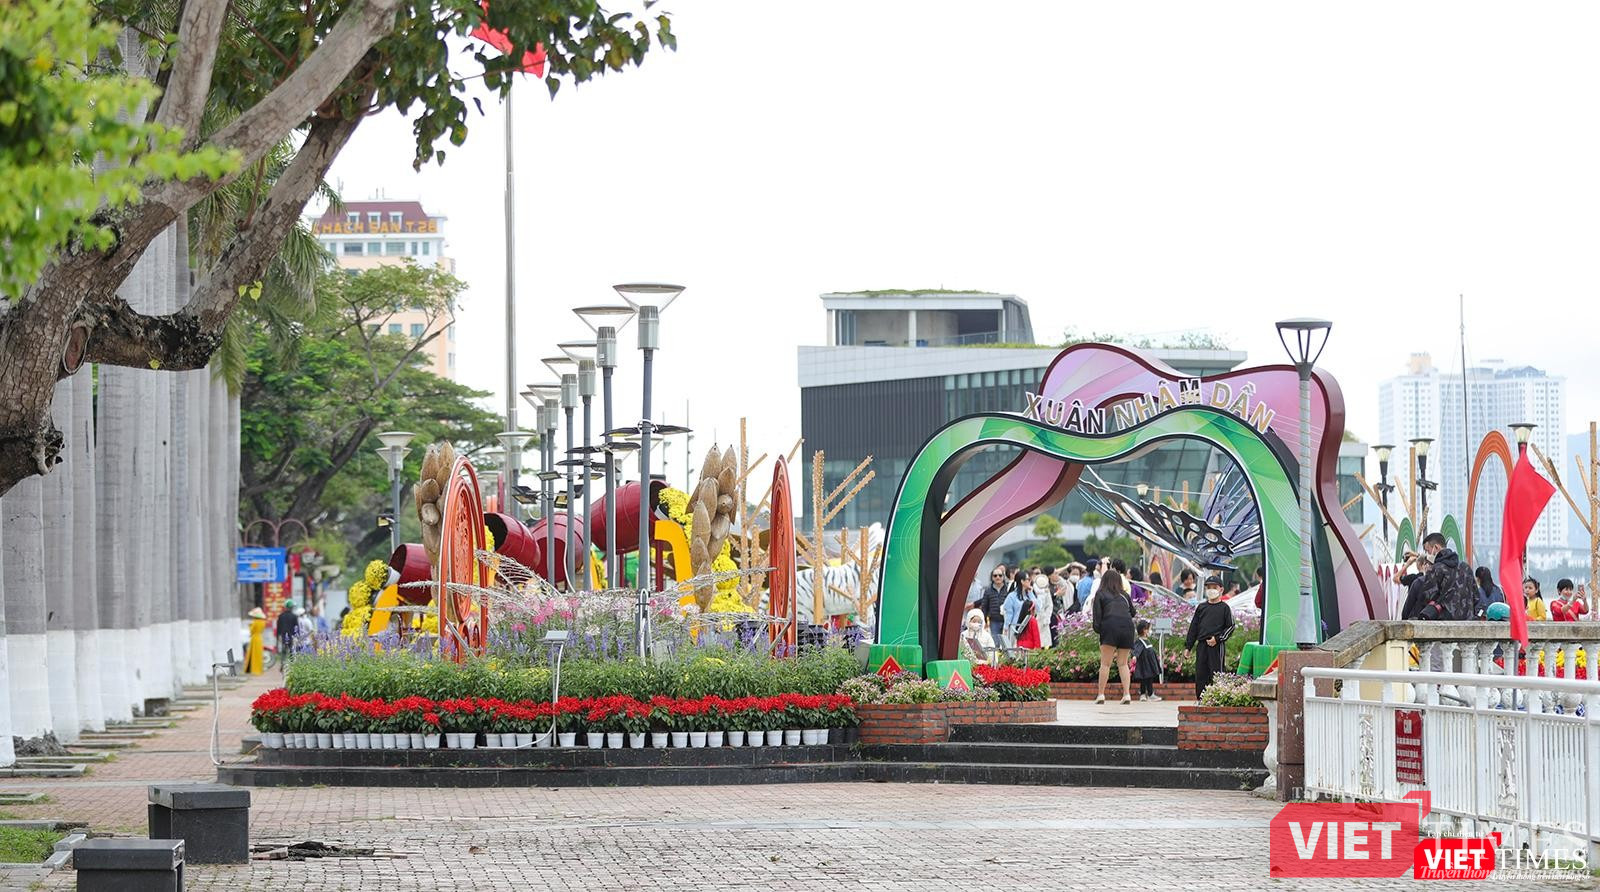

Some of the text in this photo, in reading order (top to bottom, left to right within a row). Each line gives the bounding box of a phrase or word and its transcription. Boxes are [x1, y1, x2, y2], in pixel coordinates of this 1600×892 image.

[1023, 379, 1276, 435] XUÂN NHÂM DẦN
